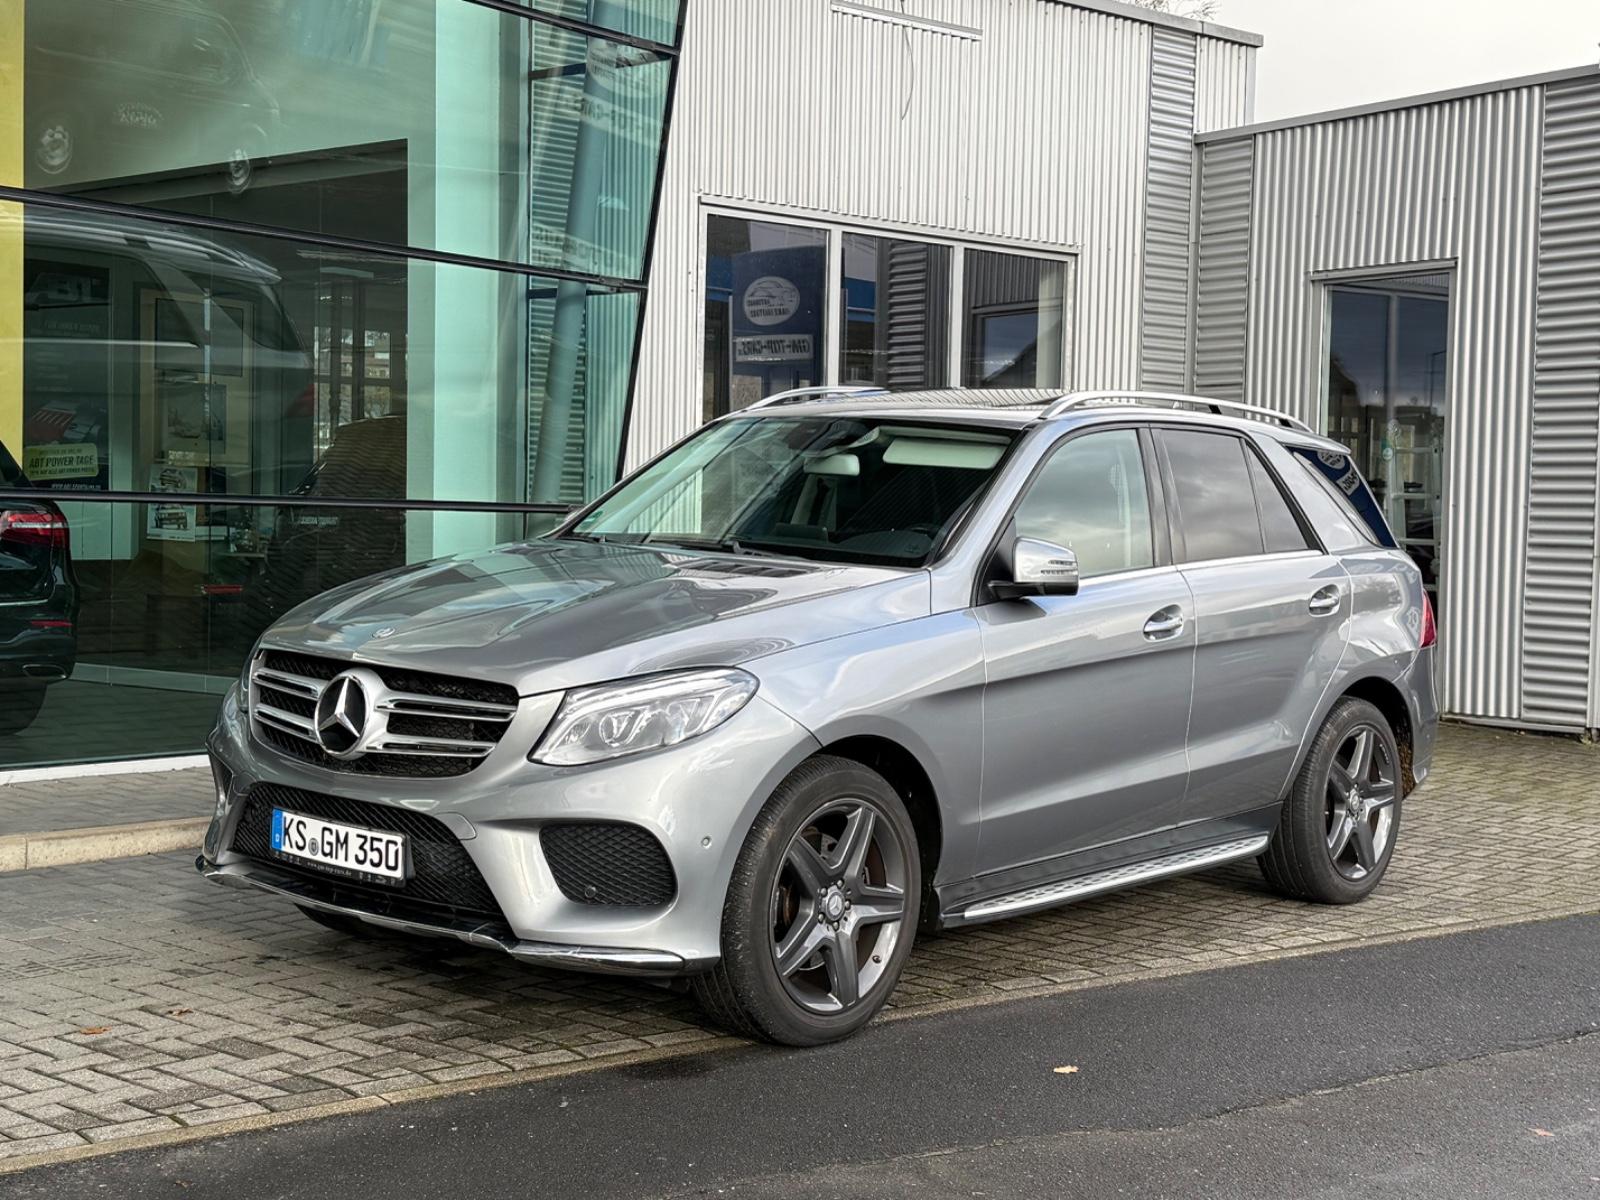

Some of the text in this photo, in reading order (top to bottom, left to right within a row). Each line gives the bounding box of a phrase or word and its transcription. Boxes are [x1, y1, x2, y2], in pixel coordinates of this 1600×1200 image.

[46, 455, 75, 467] POWER
[76, 455, 94, 466] TAGE
[282, 816, 400, 871] KS GM 350
